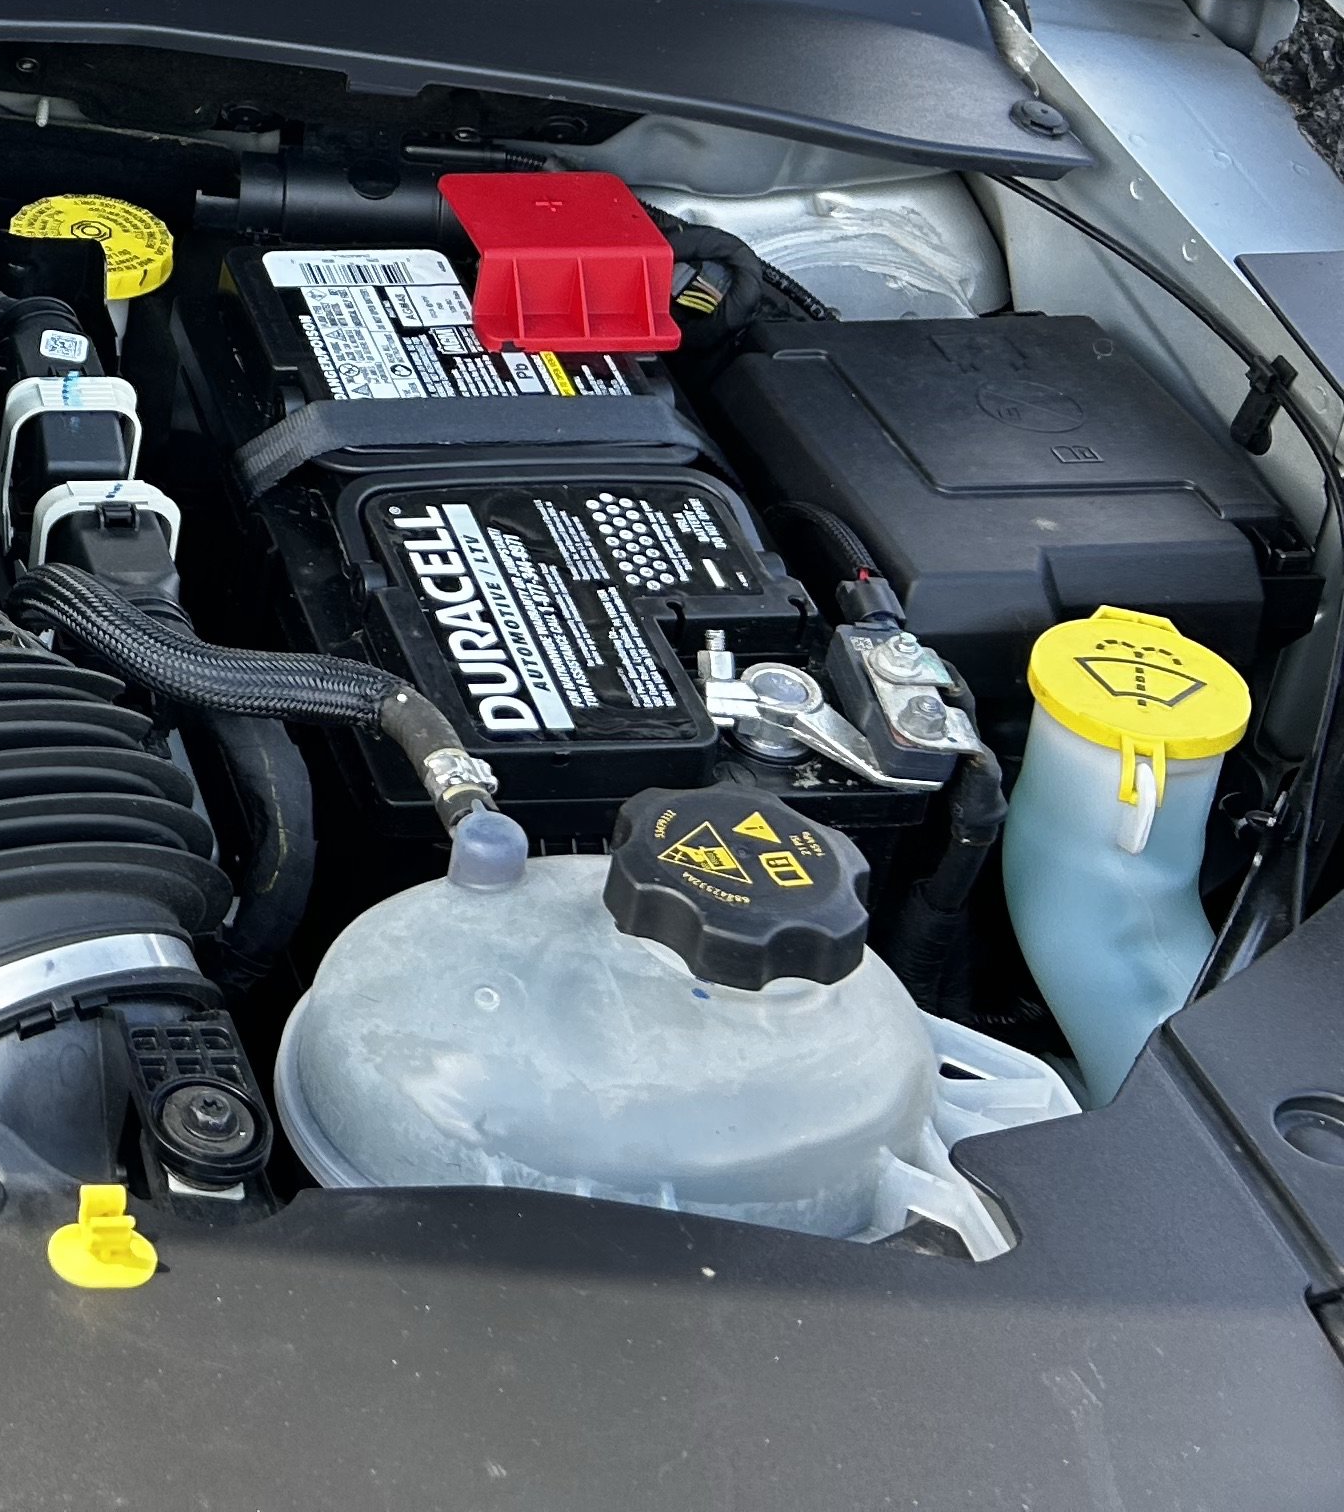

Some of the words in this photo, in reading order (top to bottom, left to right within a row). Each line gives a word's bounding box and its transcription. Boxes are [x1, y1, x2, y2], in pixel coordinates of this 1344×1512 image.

[510, 363, 534, 379] Pb
[461, 534, 491, 563] LTV
[393, 506, 541, 731] DURACELL
[490, 581, 551, 692] AUTOMOTIVE
